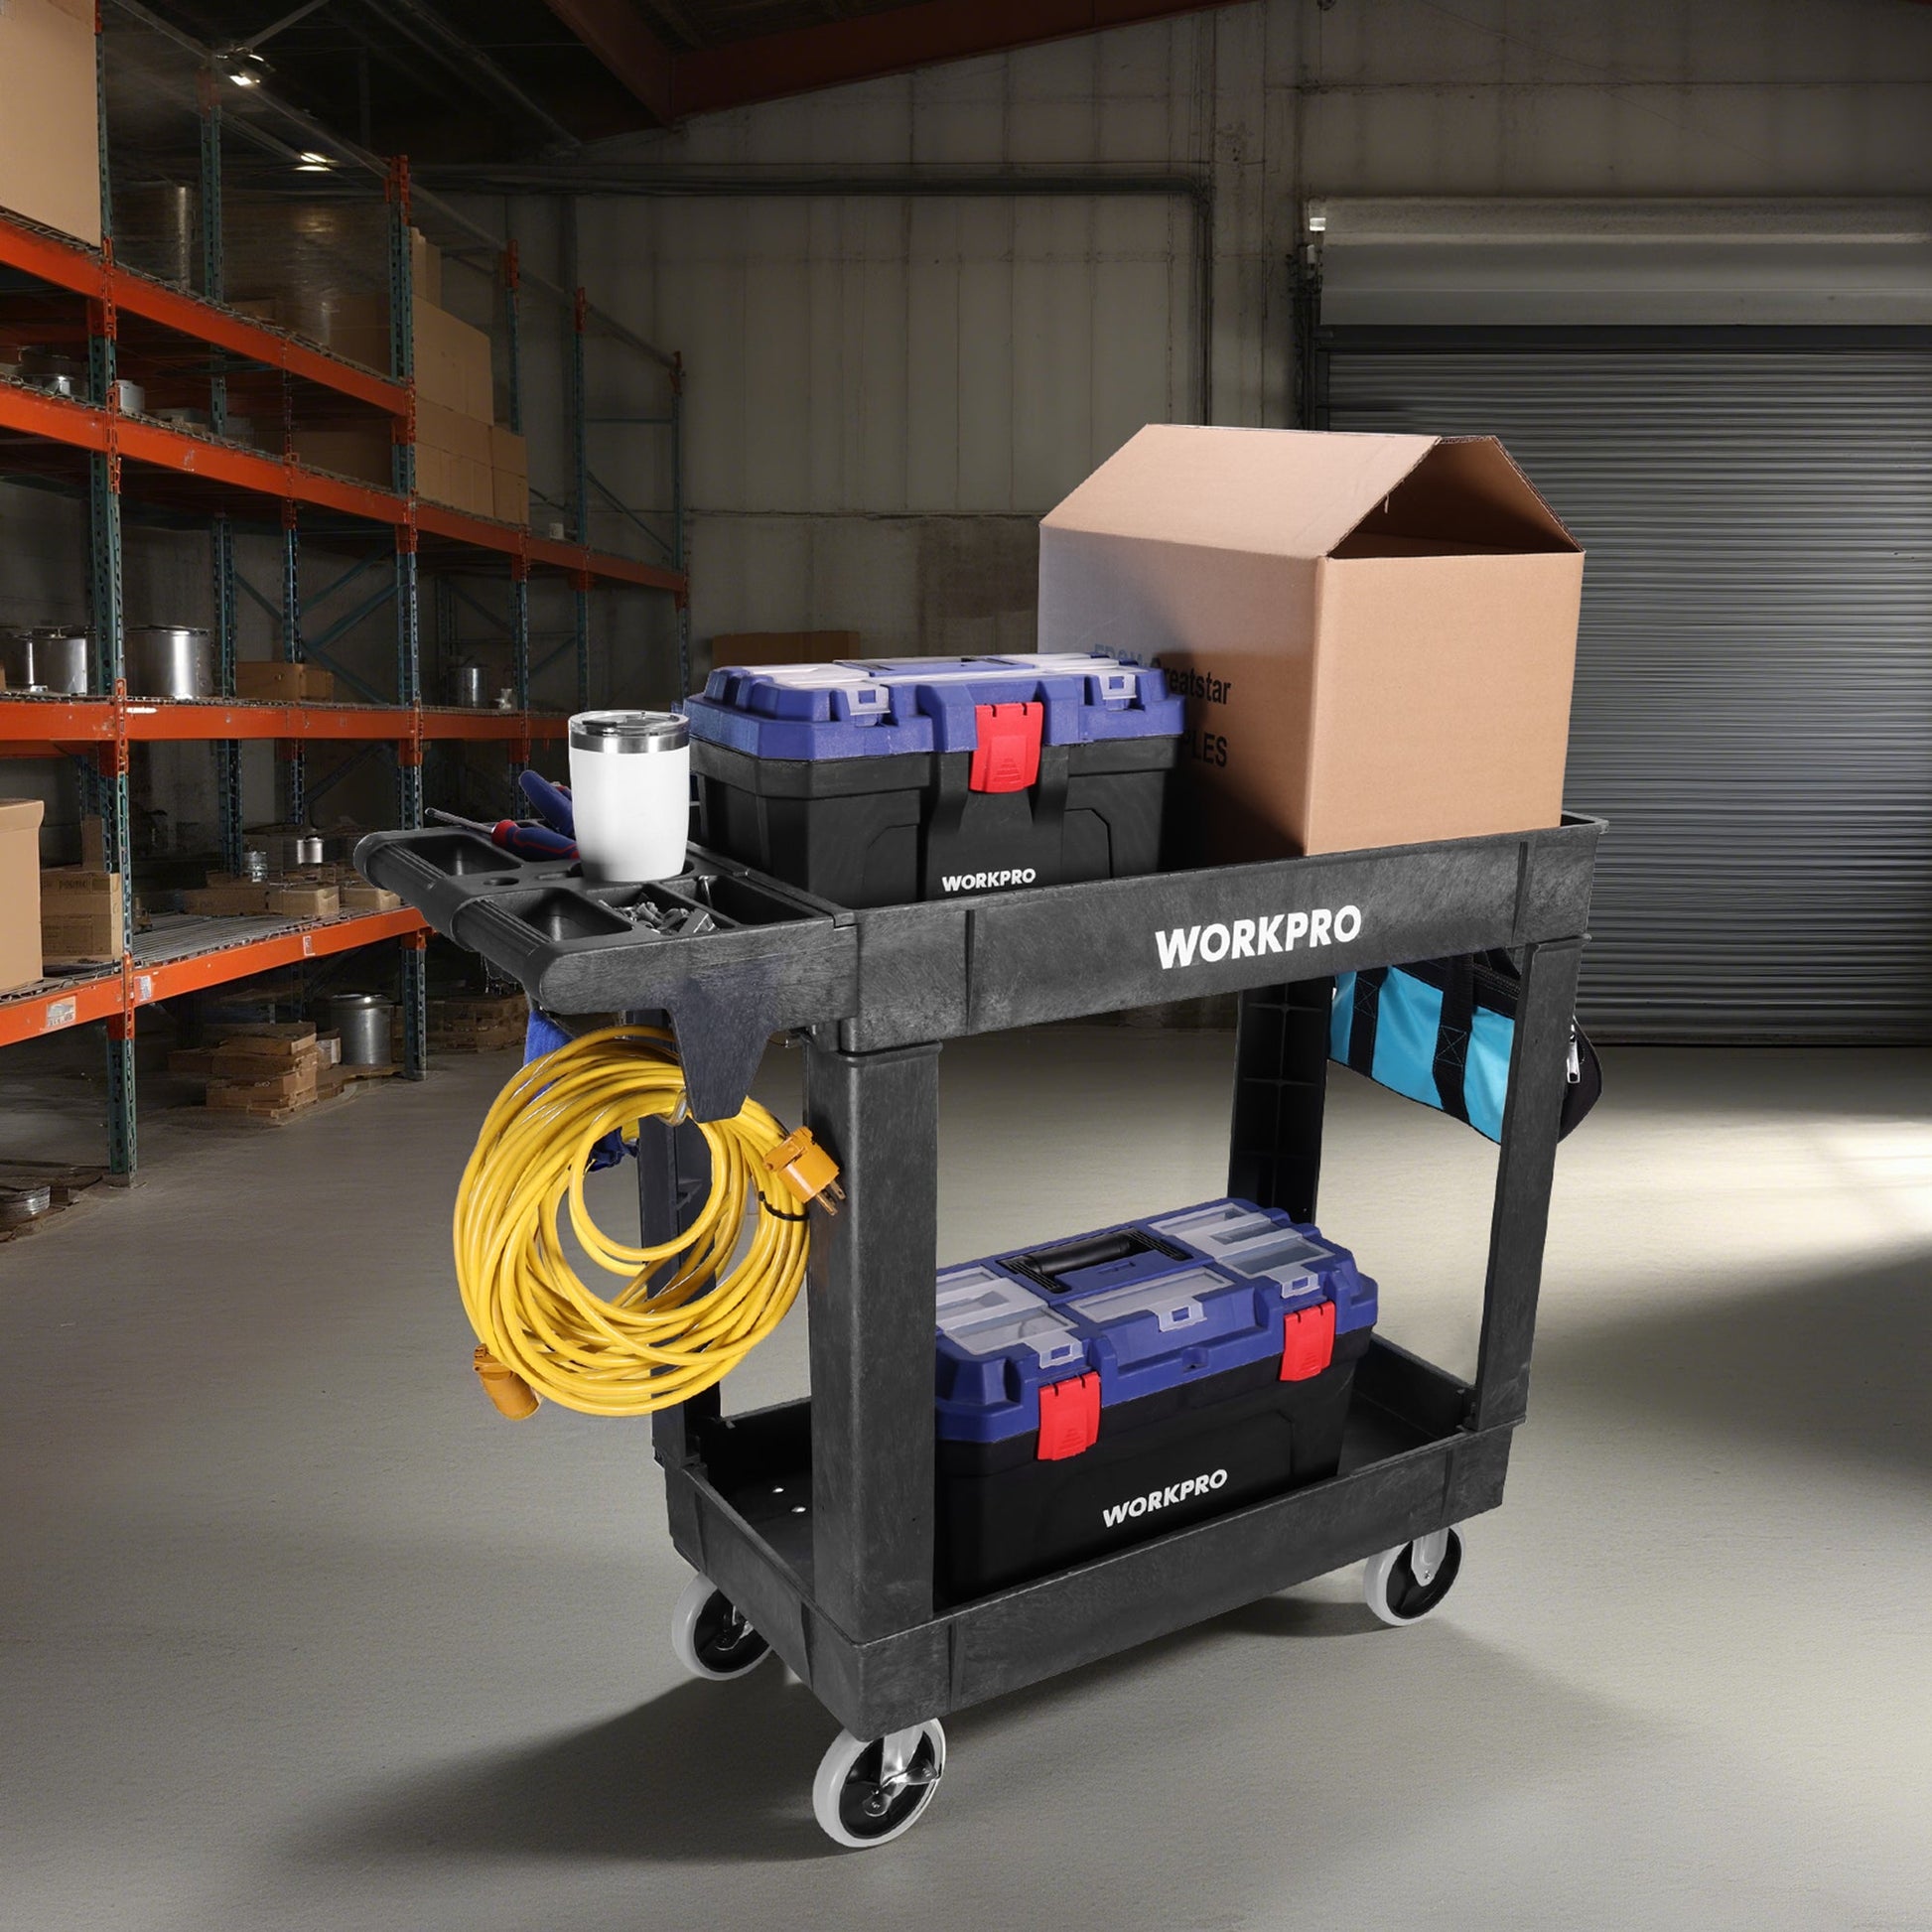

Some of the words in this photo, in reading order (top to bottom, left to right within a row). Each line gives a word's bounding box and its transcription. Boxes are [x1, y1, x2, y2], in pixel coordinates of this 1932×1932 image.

[942, 869, 1036, 893] WORKPRO
[1156, 905, 1361, 969] WORKPRO
[1103, 1469, 1228, 1527] WORKPRO
